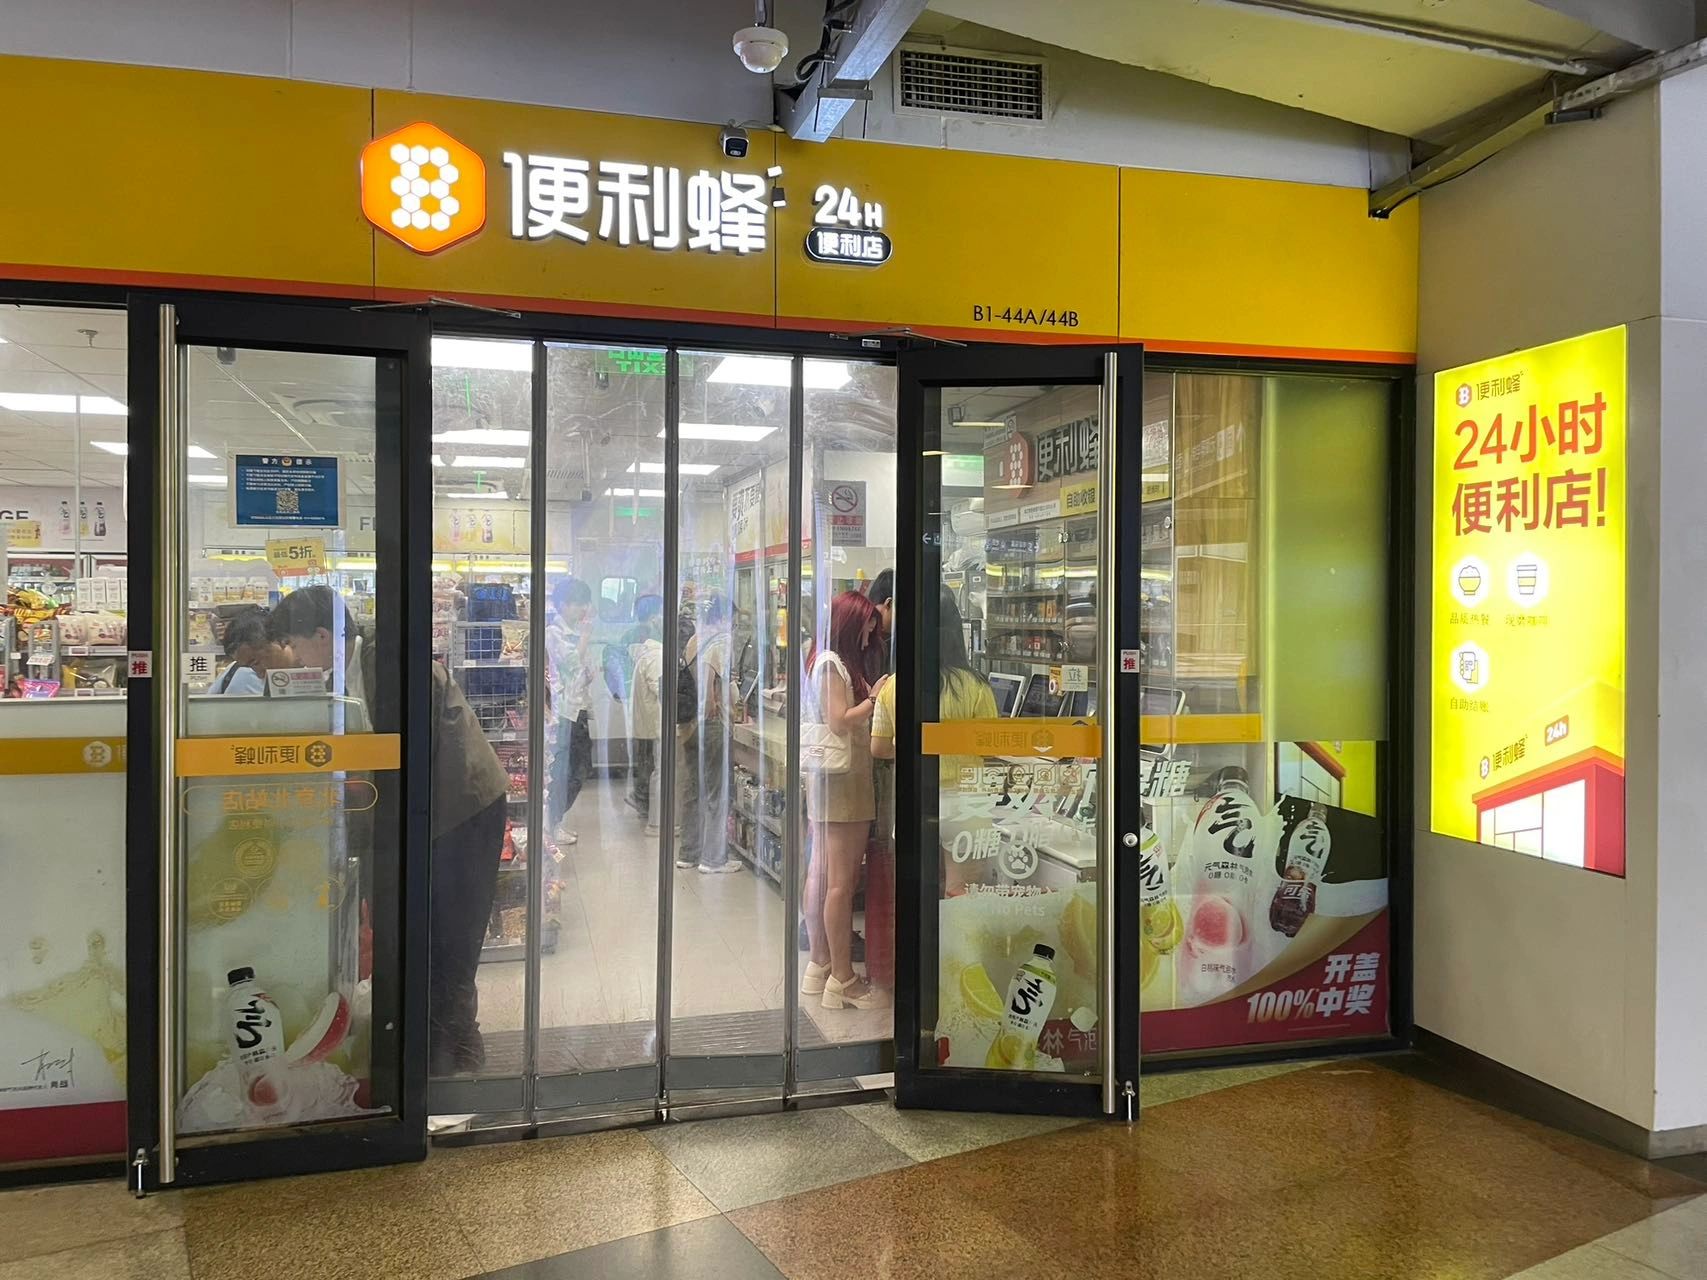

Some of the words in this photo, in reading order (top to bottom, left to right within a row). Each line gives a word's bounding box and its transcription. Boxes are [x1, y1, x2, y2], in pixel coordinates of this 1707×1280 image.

[503, 152, 768, 255] 便利蜂
[814, 184, 883, 228] 24H
[817, 231, 884, 259] 便利店
[973, 305, 1079, 327] B1-44A/44B
[1476, 373, 1521, 401] 便利蜂
[1453, 391, 1607, 470] 24小时
[1452, 467, 1607, 536] 便利店!
[131, 660, 148, 675] 推
[190, 656, 208, 672] 推
[1123, 657, 1136, 670] 推
[1546, 720, 1567, 745] 24h
[992, 904, 1010, 915] No
[1015, 904, 1045, 917] Pets
[1323, 952, 1381, 984] 开盖
[1247, 984, 1376, 1024] 100%中奖
